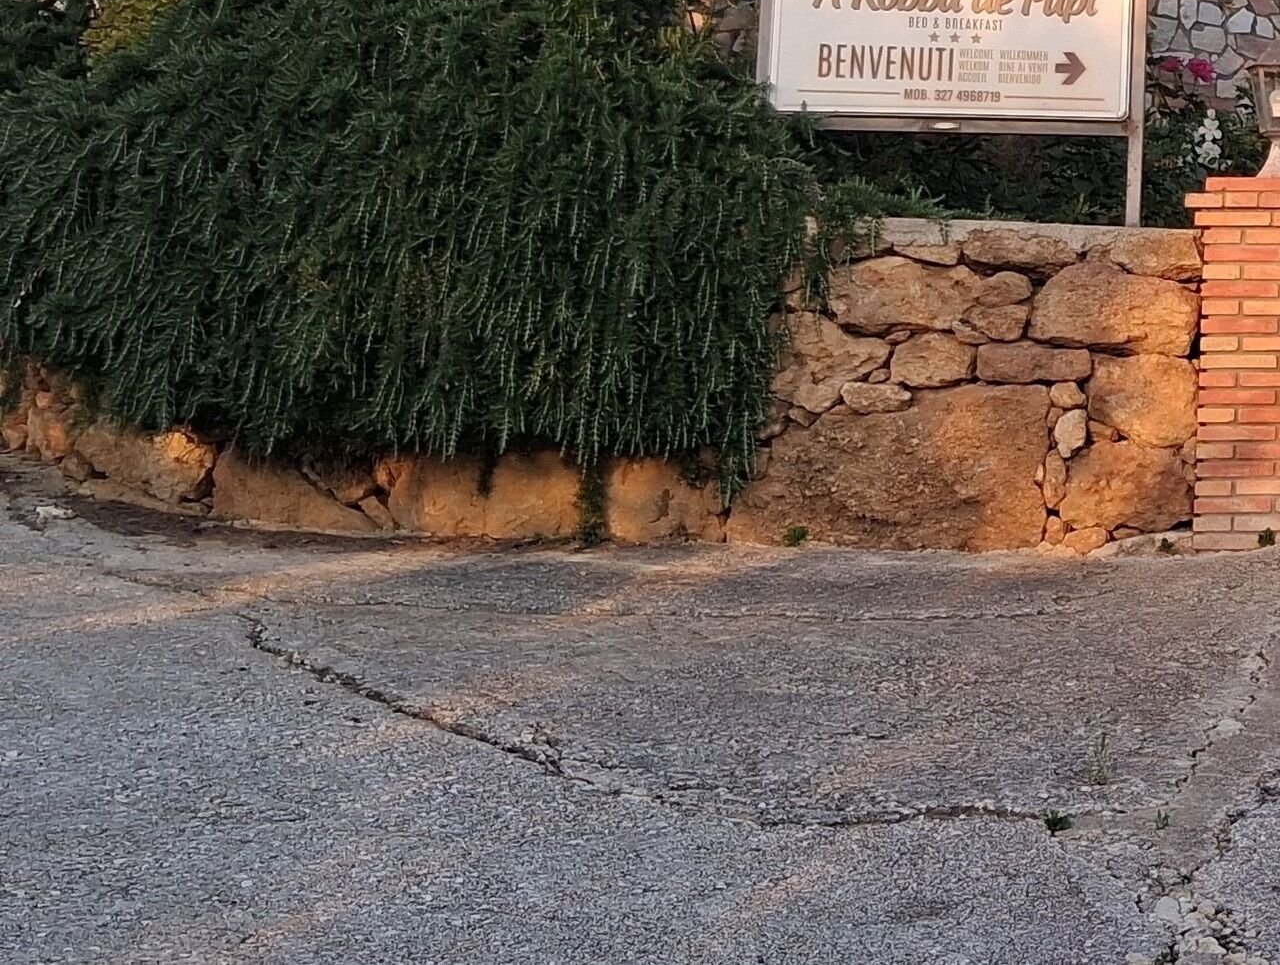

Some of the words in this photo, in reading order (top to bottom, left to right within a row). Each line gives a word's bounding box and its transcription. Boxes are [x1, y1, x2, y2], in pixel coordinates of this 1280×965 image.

[908, 16, 928, 28] BED
[932, 17, 940, 29] &
[945, 17, 1003, 31] BREAKFAST
[959, 48, 995, 60] WELCOME
[999, 49, 1049, 61] WILLKOMMEN
[818, 43, 954, 82] BENVENUTI
[959, 60, 990, 72] WELKOM
[998, 73, 1042, 85] BIENVENIDO
[903, 89, 930, 101] MOB.
[934, 90, 954, 102] 327
[956, 90, 1001, 103] 4968719
